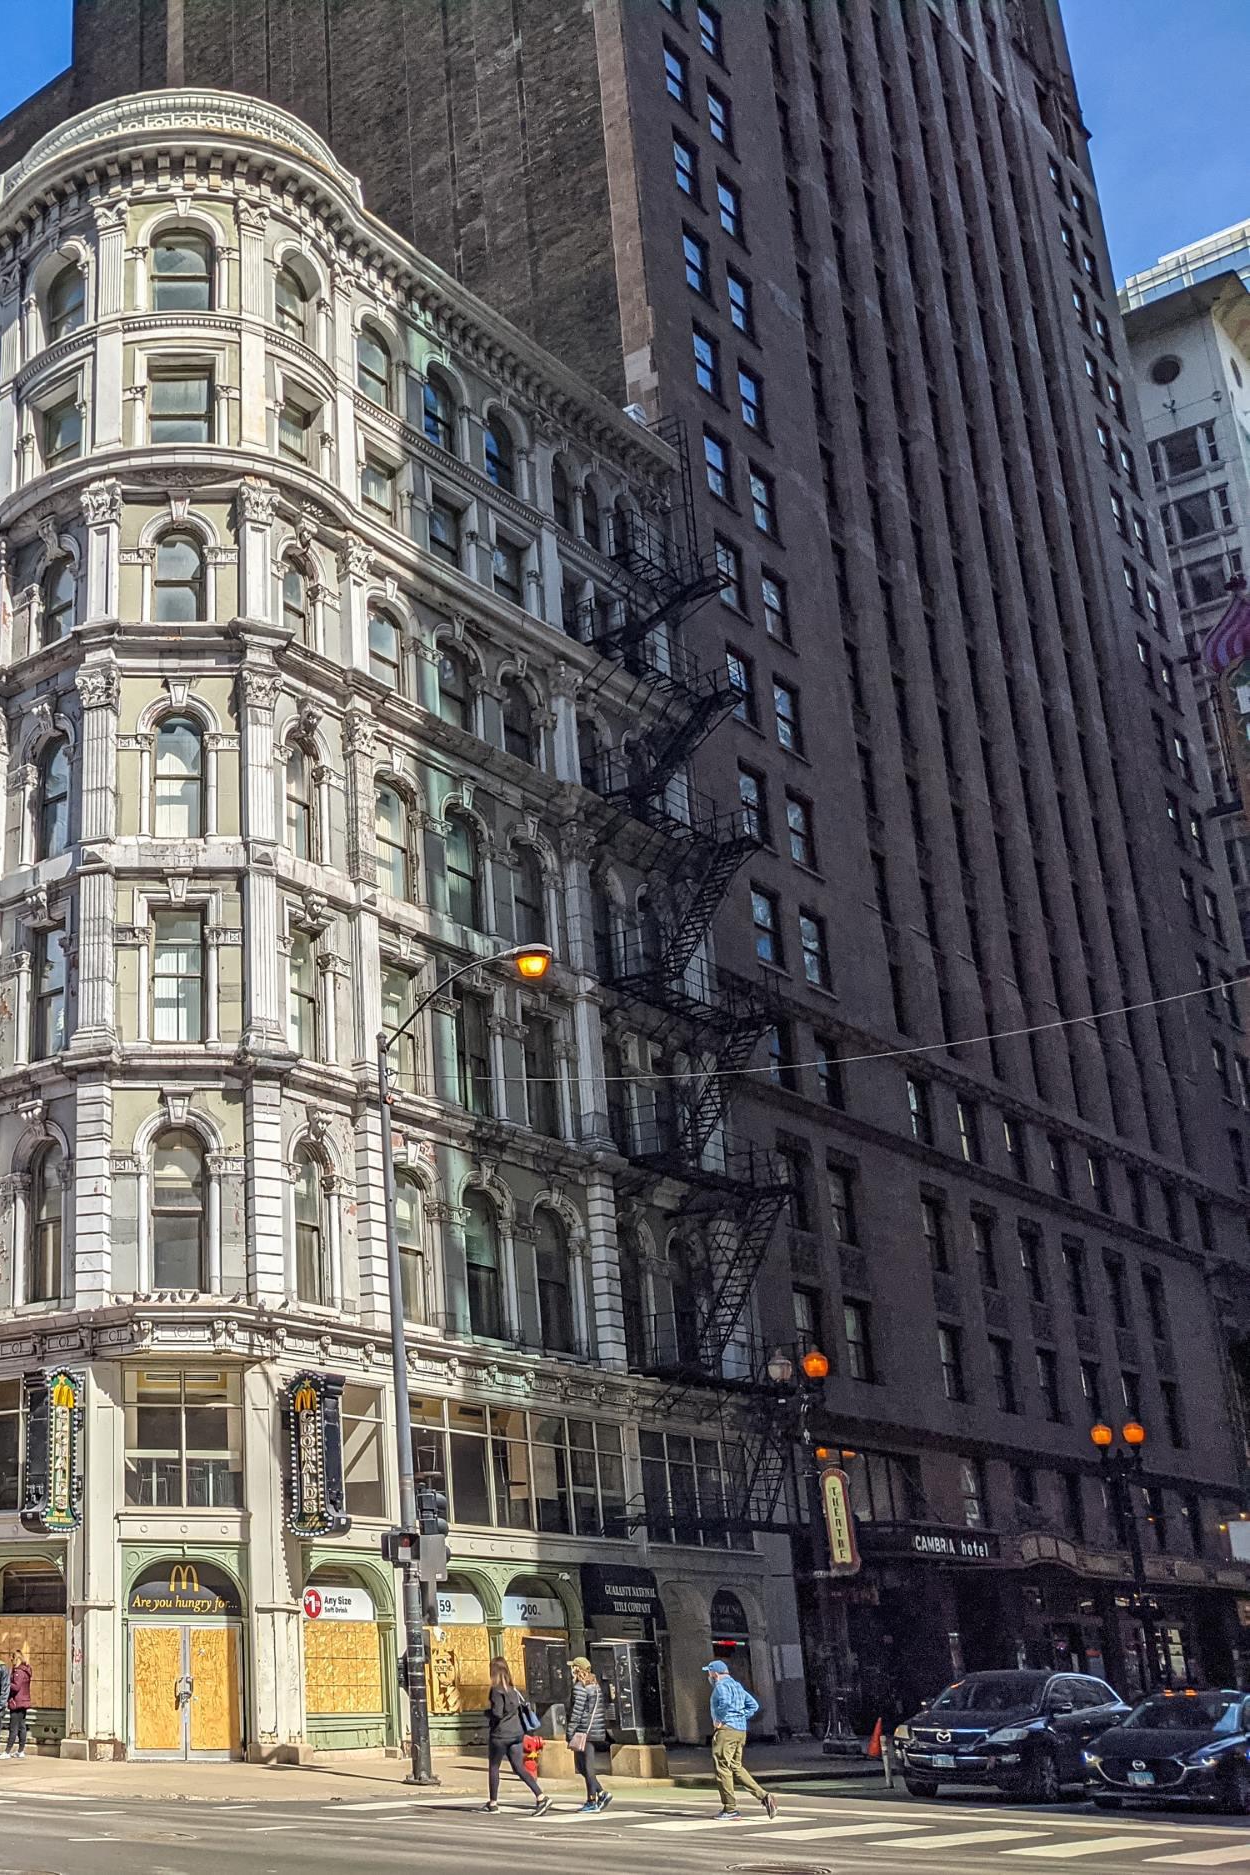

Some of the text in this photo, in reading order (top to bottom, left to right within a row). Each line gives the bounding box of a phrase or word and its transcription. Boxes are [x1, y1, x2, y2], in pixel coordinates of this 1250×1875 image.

[831, 1486, 846, 1559] THEATRE
[915, 1535, 989, 1557] CAMBRIA hotel
[132, 1594, 238, 1612] Are you hungry for...
[324, 1596, 337, 1606] Any
[337, 1596, 352, 1605] Size
[627, 1602, 651, 1613] COMPANY
